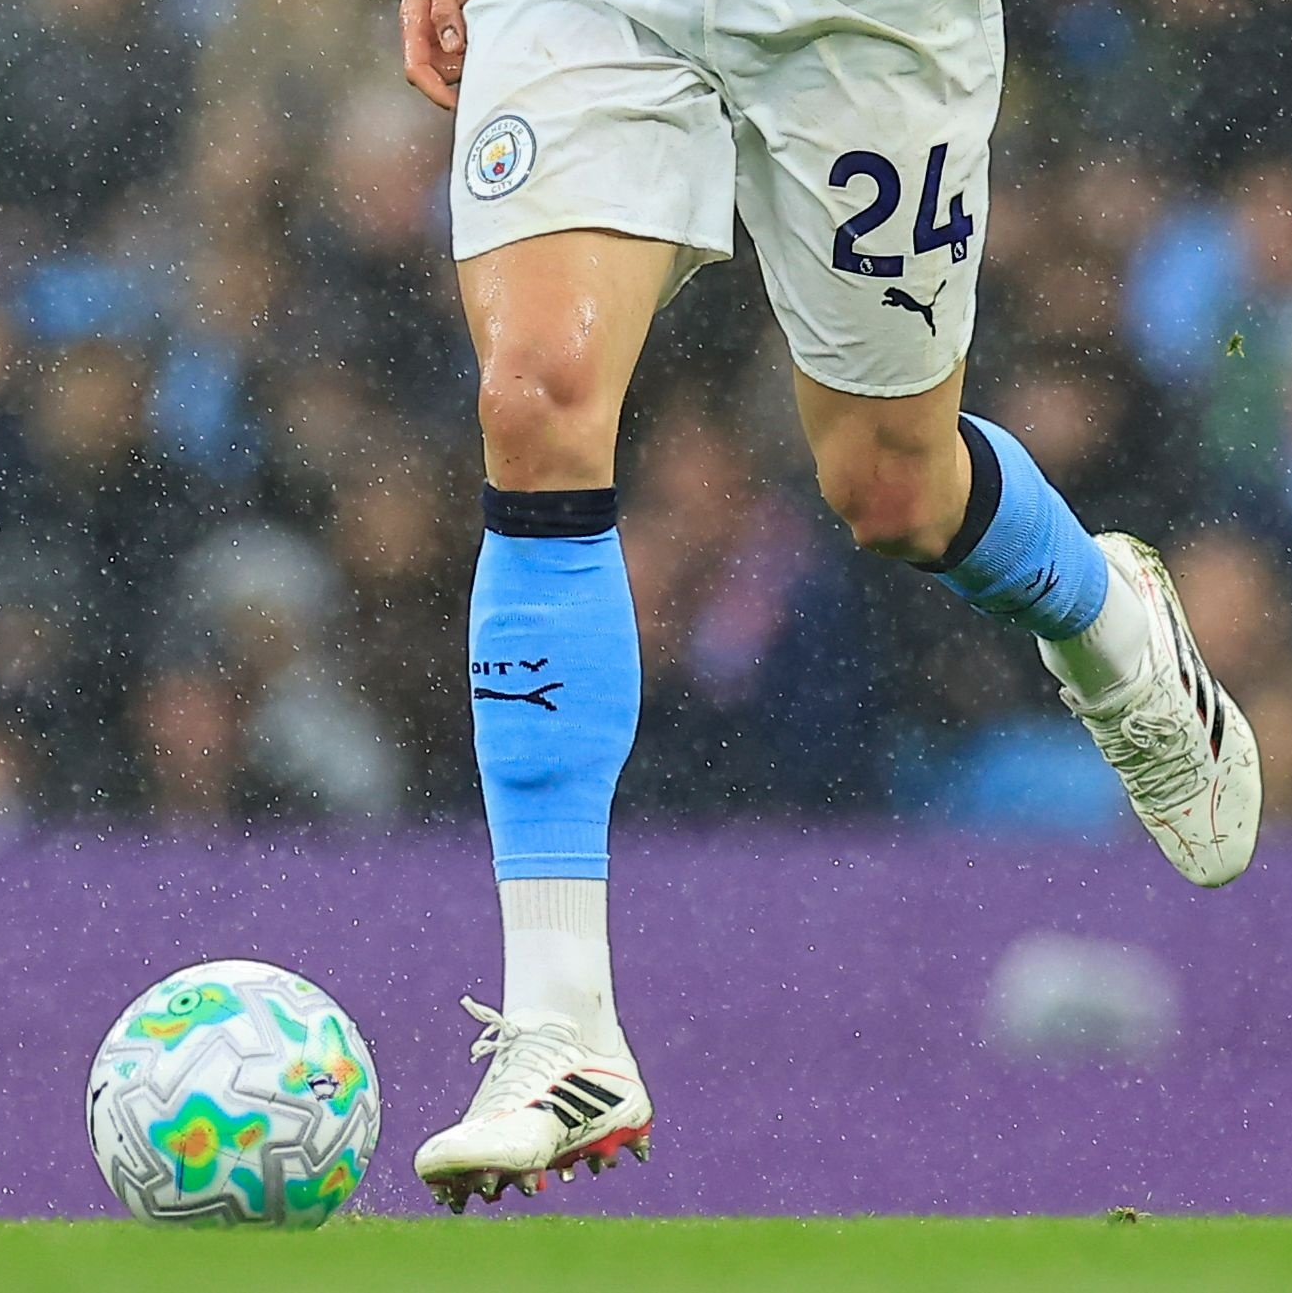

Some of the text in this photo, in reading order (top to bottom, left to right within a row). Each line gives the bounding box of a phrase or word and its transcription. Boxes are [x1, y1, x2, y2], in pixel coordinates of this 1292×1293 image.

[471, 121, 524, 162] MANCHESTER
[490, 178, 514, 194] CITY
[828, 142, 974, 278] 24
